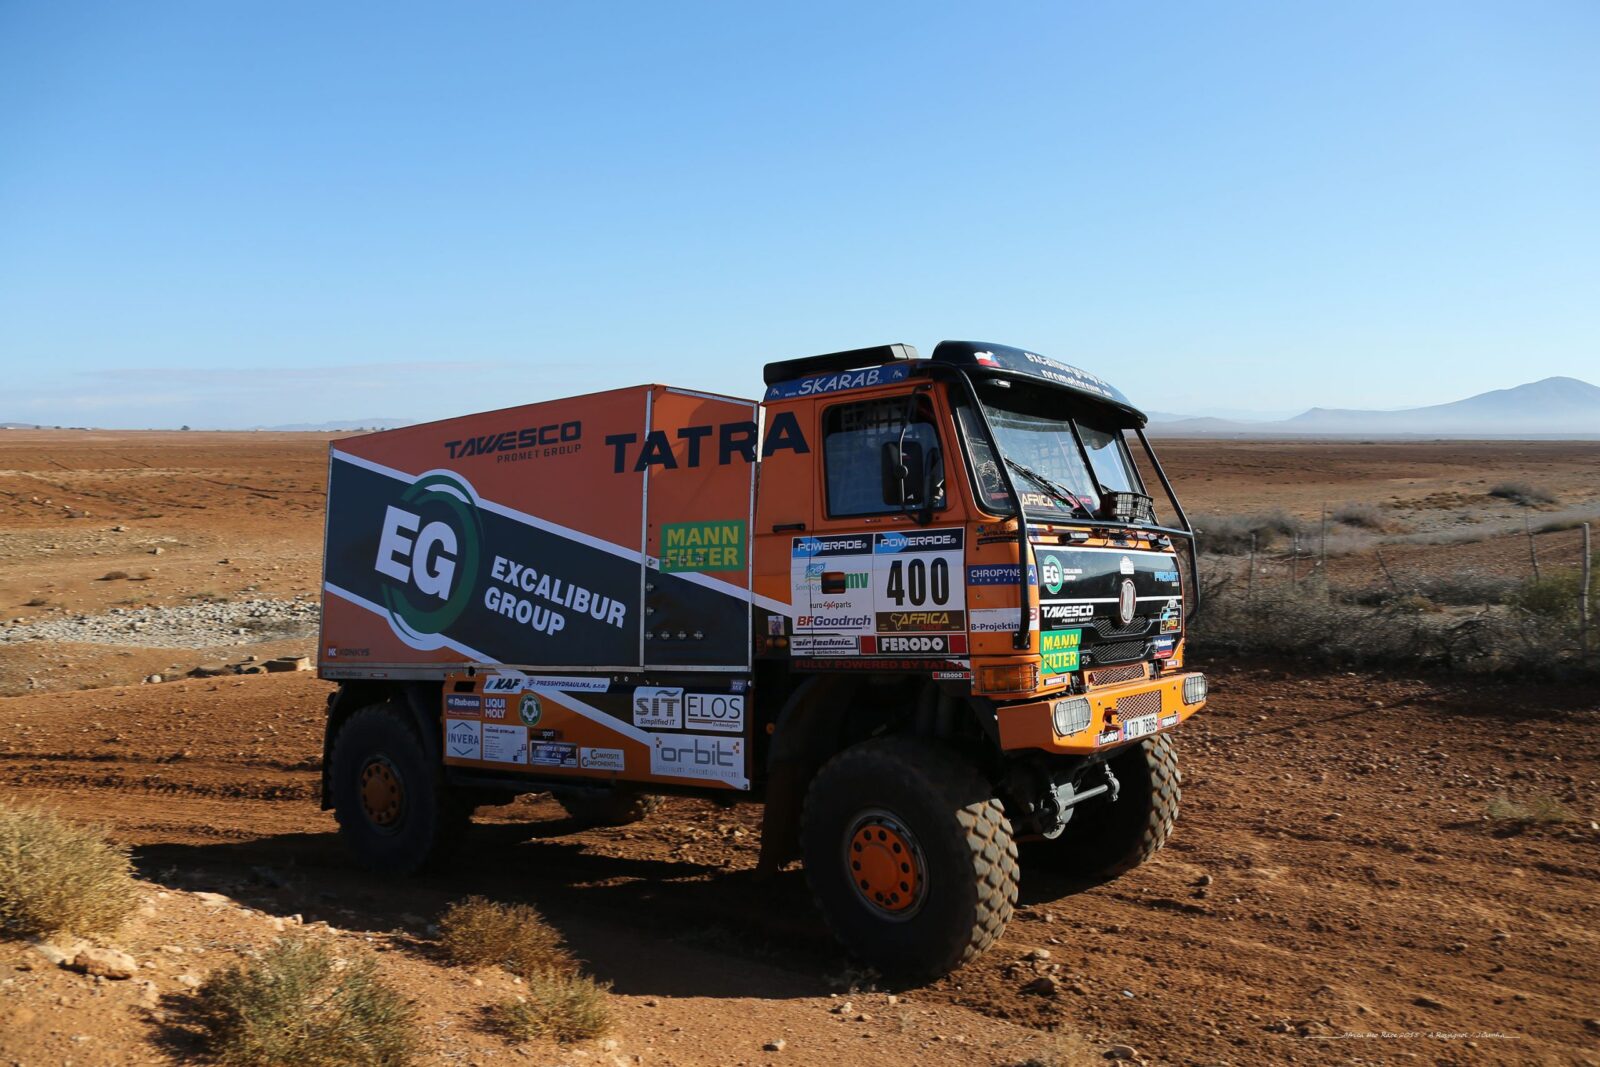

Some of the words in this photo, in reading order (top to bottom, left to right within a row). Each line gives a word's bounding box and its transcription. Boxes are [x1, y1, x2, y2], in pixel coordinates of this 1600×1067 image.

[798, 369, 879, 395] SKARAB
[444, 420, 582, 460] TAWESCO
[605, 411, 811, 474] TATRA
[496, 450, 540, 464] PROMET
[543, 443, 582, 457] GROUP
[1022, 493, 1055, 507] AFRICA
[667, 526, 739, 547] MANN
[881, 535, 951, 548] POWERADE
[374, 504, 459, 602] EG
[798, 540, 862, 552] POWERADE
[665, 547, 738, 568] FILTER
[887, 557, 950, 607] 400
[1043, 565, 1060, 583] EG
[491, 555, 627, 629] EXCALIBUR
[484, 586, 566, 637] GROUP
[898, 612, 950, 627] AFRICA
[1041, 605, 1094, 619] TAWESCO
[797, 615, 871, 627] BFGoodrich
[970, 622, 1020, 632] B-Projektin
[881, 637, 944, 652] FERODO
[1043, 634, 1079, 652] MANN
[794, 659, 833, 669] FULLY
[835, 659, 898, 669] POWERED
[1043, 651, 1077, 670] FILTER
[485, 698, 506, 709] LIQUI
[687, 696, 741, 720] ELOS
[485, 708, 506, 719] MOLY
[640, 718, 669, 727] Simplified
[447, 732, 480, 745] INVERA
[661, 739, 734, 767] orbit
